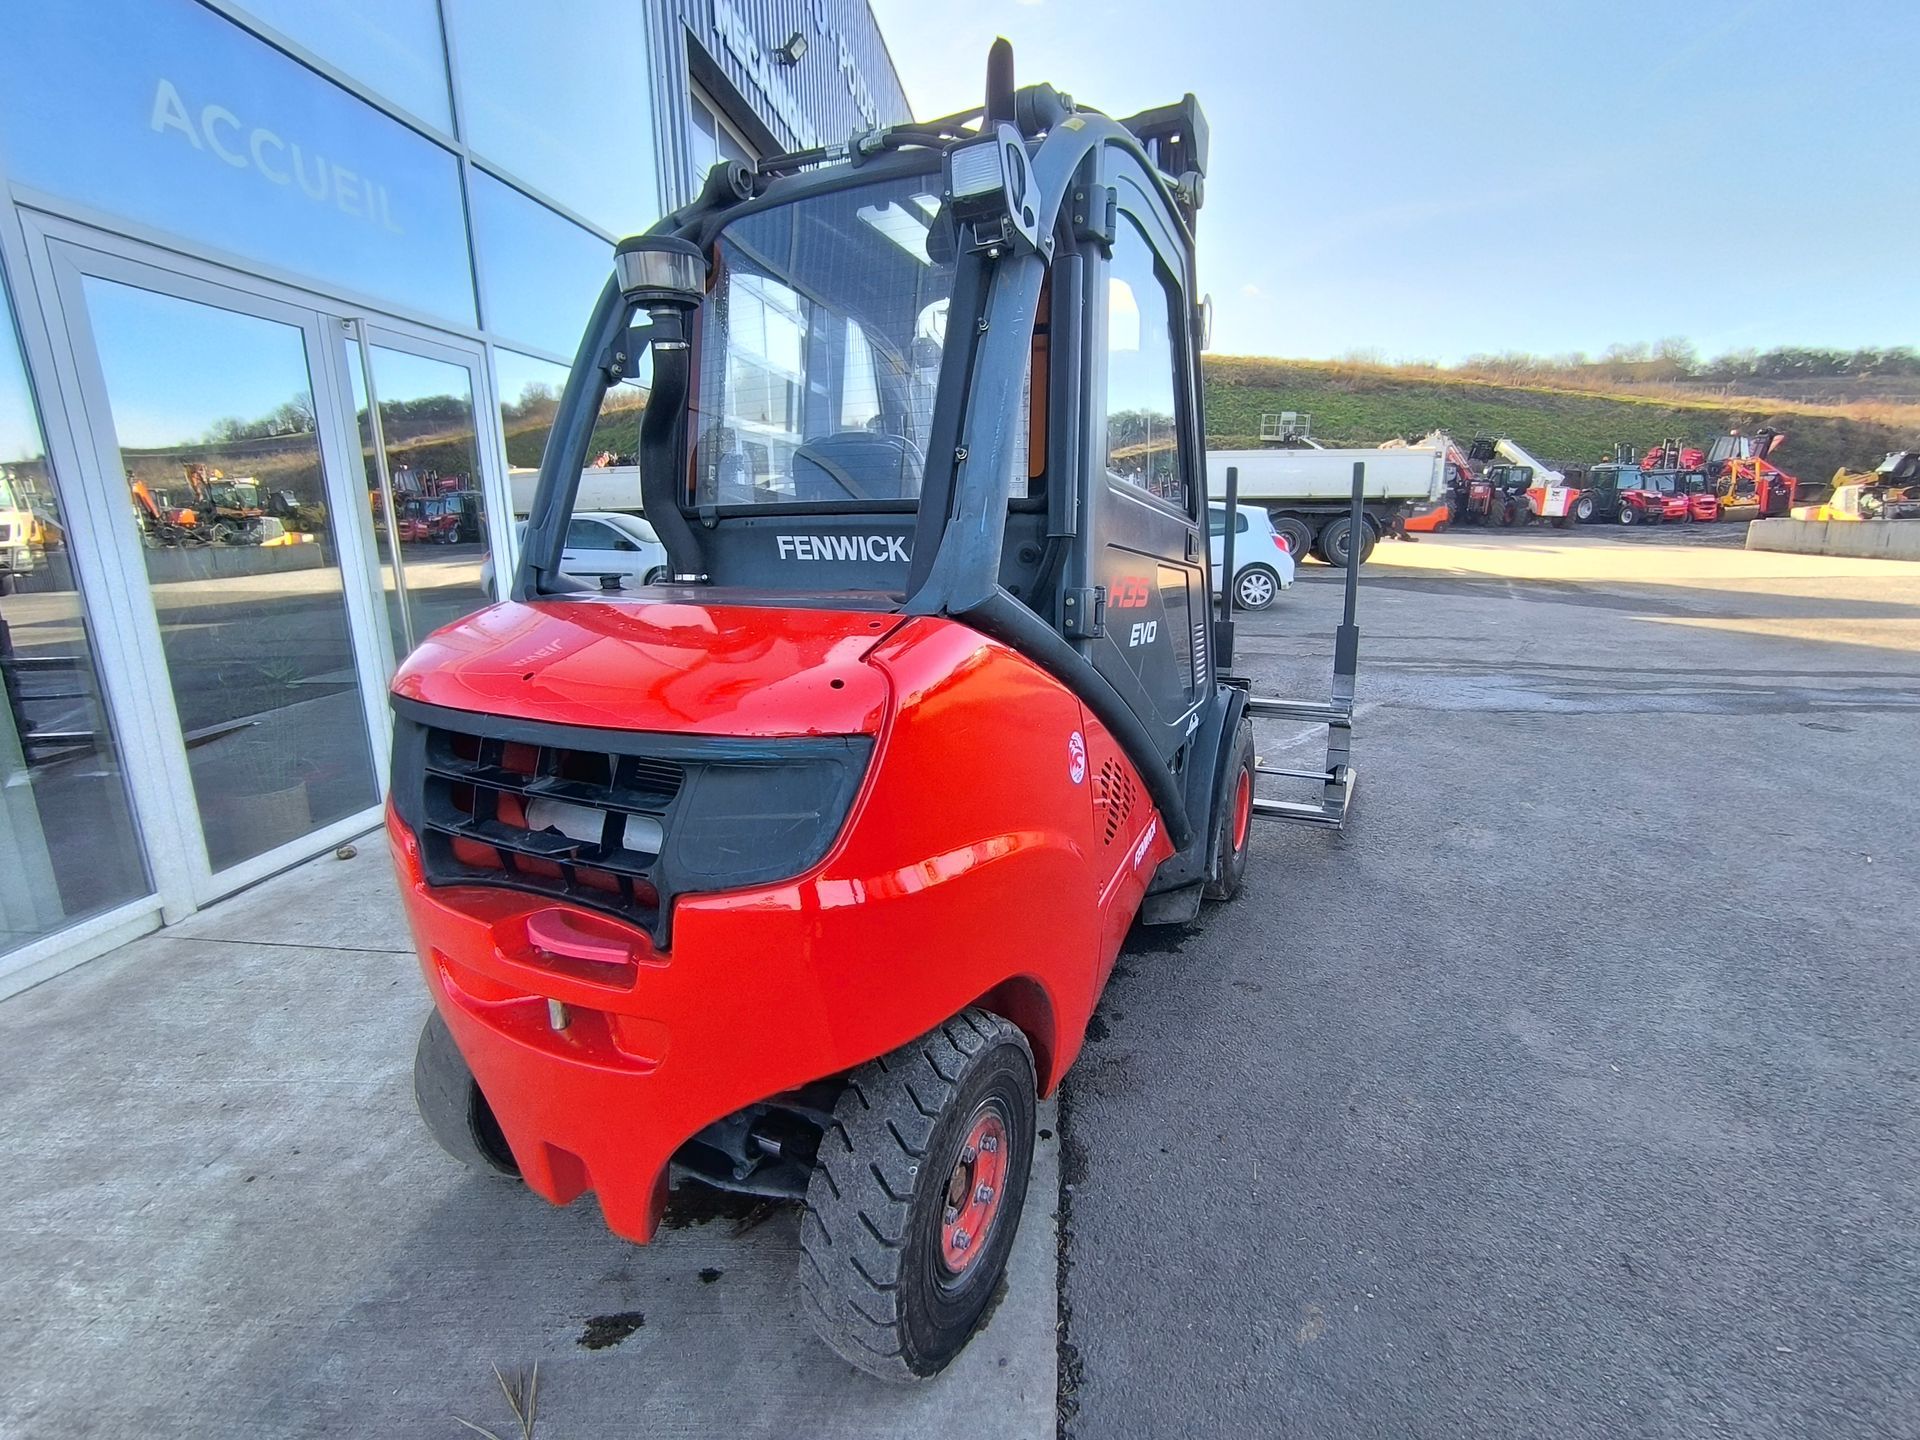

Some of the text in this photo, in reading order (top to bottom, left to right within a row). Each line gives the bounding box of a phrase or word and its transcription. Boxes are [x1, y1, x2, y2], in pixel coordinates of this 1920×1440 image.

[151, 78, 405, 235] ACCUEIL
[776, 535, 911, 562] FENWICK
[1107, 576, 1149, 608] H35
[1129, 621, 1157, 648] EVO
